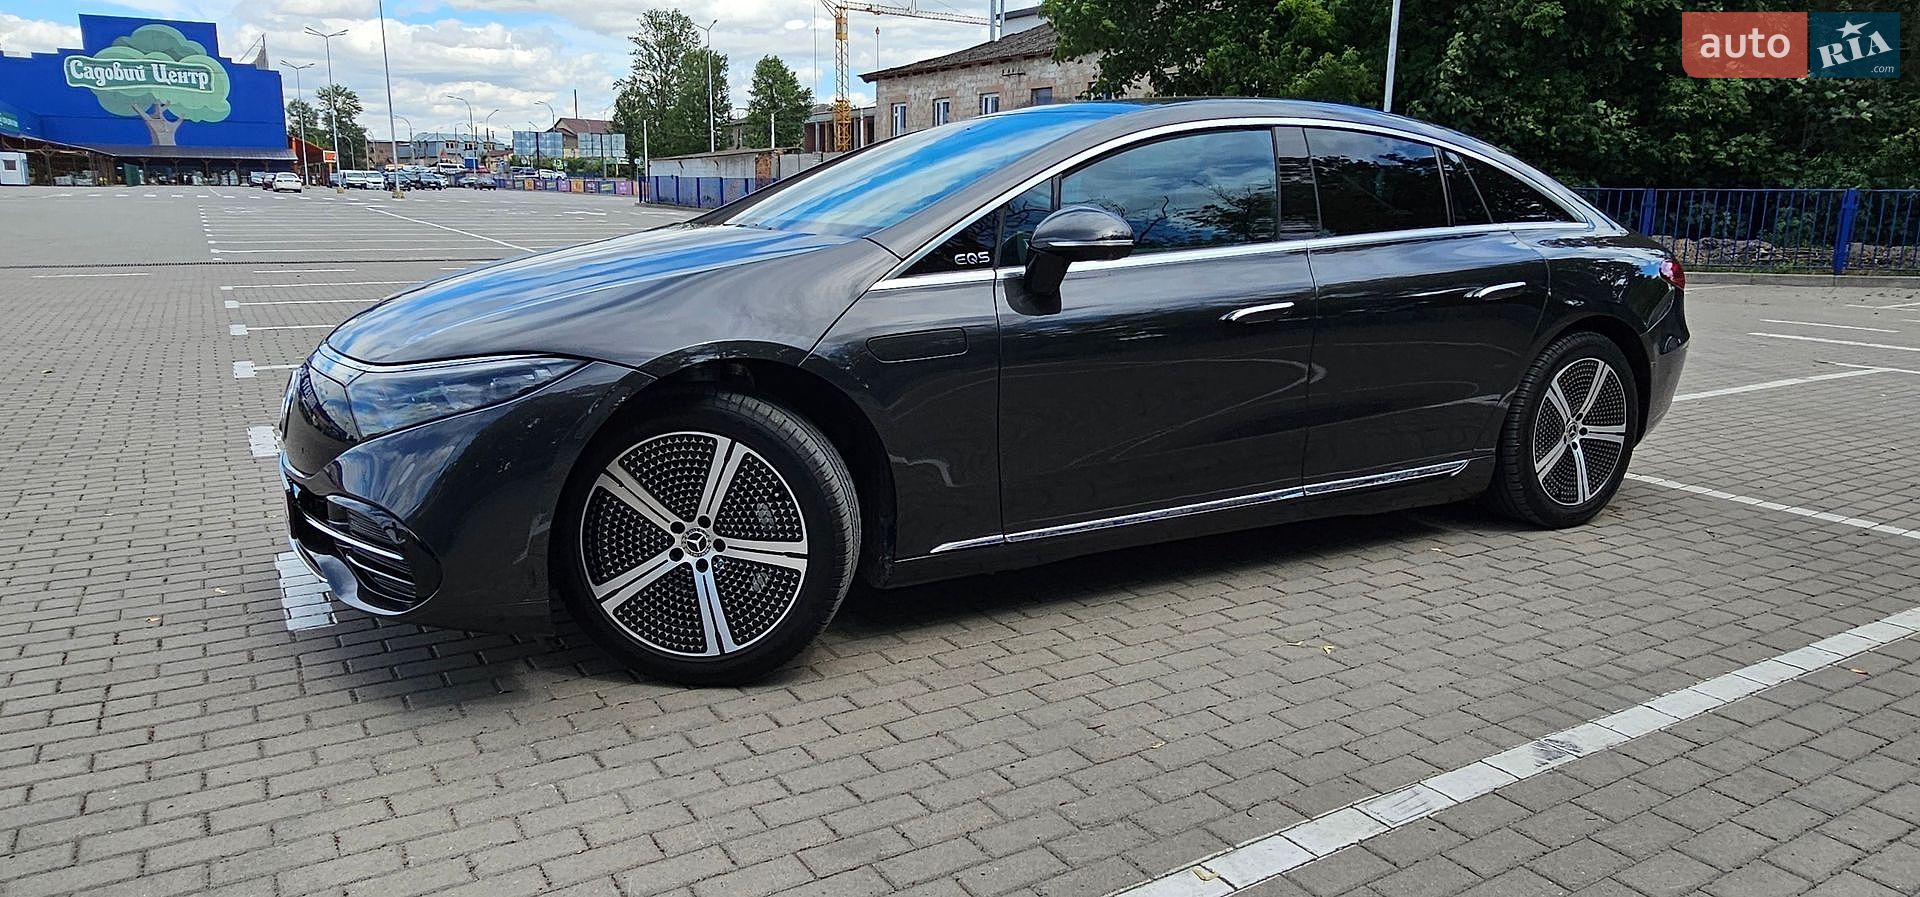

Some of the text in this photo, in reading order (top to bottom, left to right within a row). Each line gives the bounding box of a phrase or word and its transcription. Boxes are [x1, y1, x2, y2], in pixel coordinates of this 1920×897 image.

[69, 59, 209, 90] Садовий Центр
[954, 251, 990, 265] EQS
